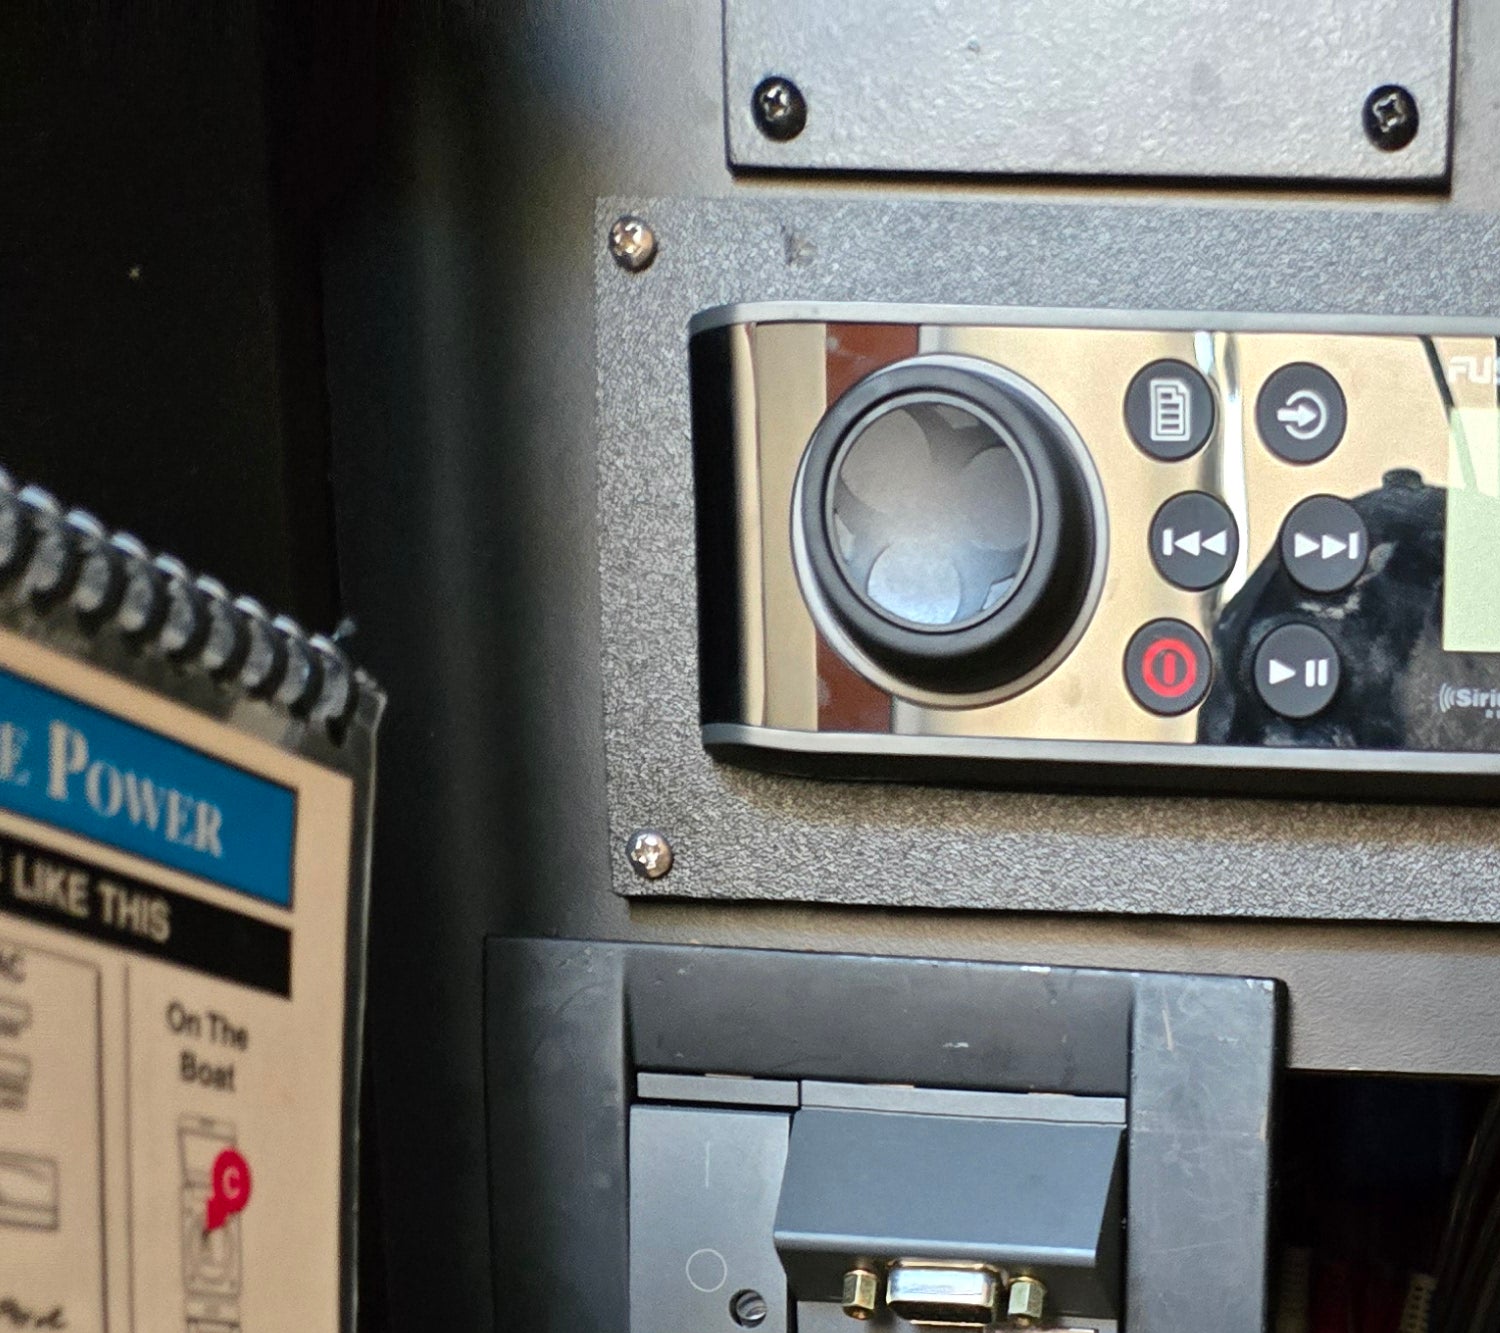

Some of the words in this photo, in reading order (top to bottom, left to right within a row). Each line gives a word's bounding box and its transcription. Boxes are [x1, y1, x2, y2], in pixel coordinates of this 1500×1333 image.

[13, 852, 90, 919] LIKE
[98, 881, 172, 943] THIS
[166, 1002, 203, 1035] On
[207, 1012, 248, 1051] The
[180, 1053, 234, 1092] Boat
